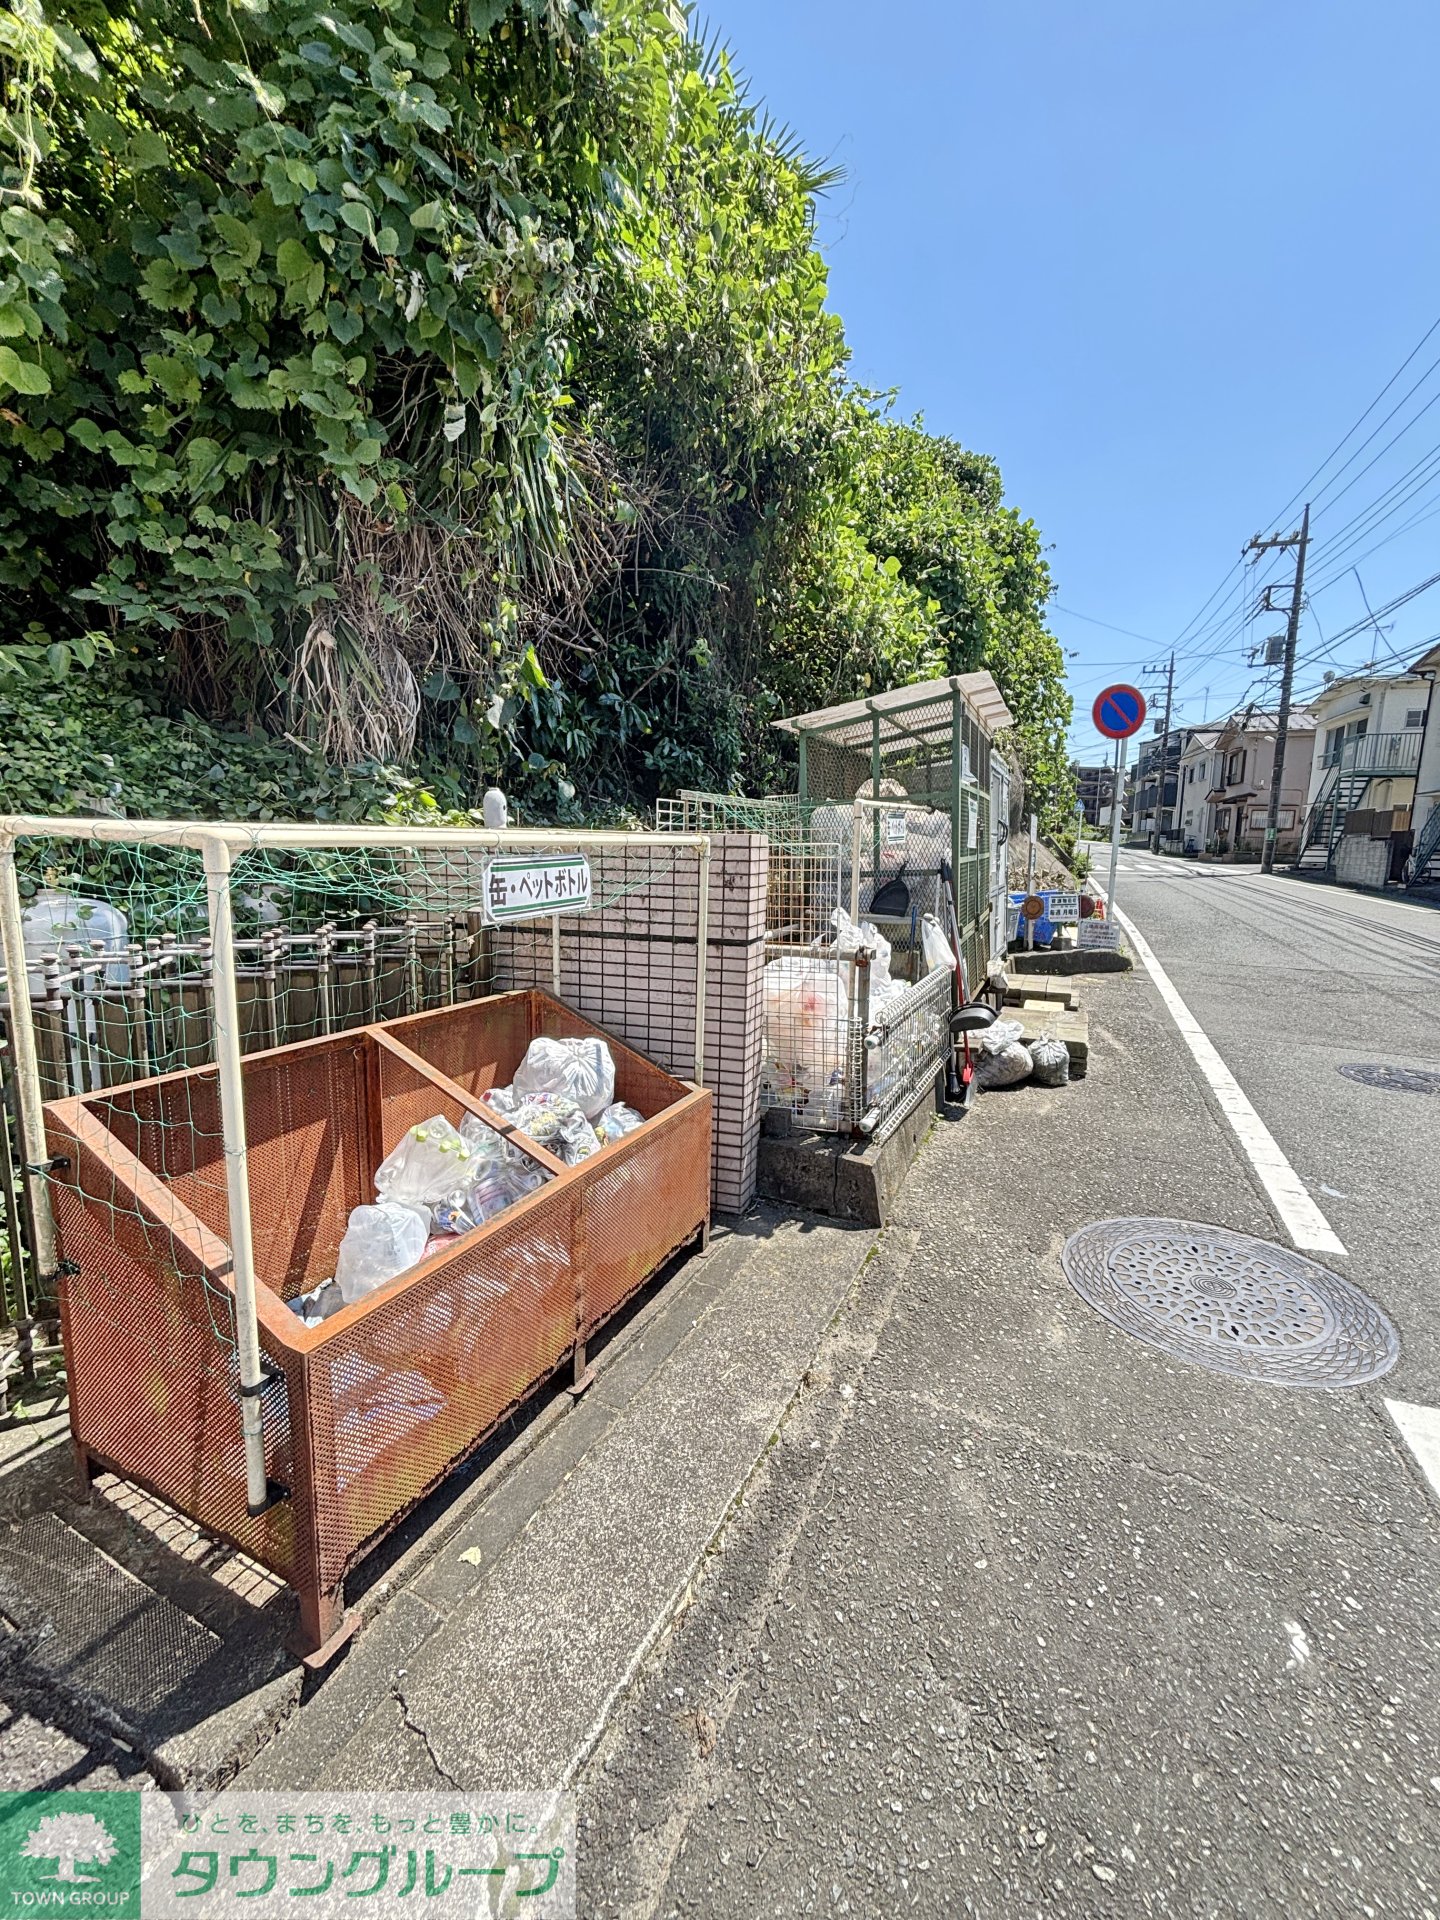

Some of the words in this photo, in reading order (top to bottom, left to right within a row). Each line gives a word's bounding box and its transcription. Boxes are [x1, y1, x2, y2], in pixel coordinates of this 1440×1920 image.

[489, 868, 588, 907] 缶・ペットボトル
